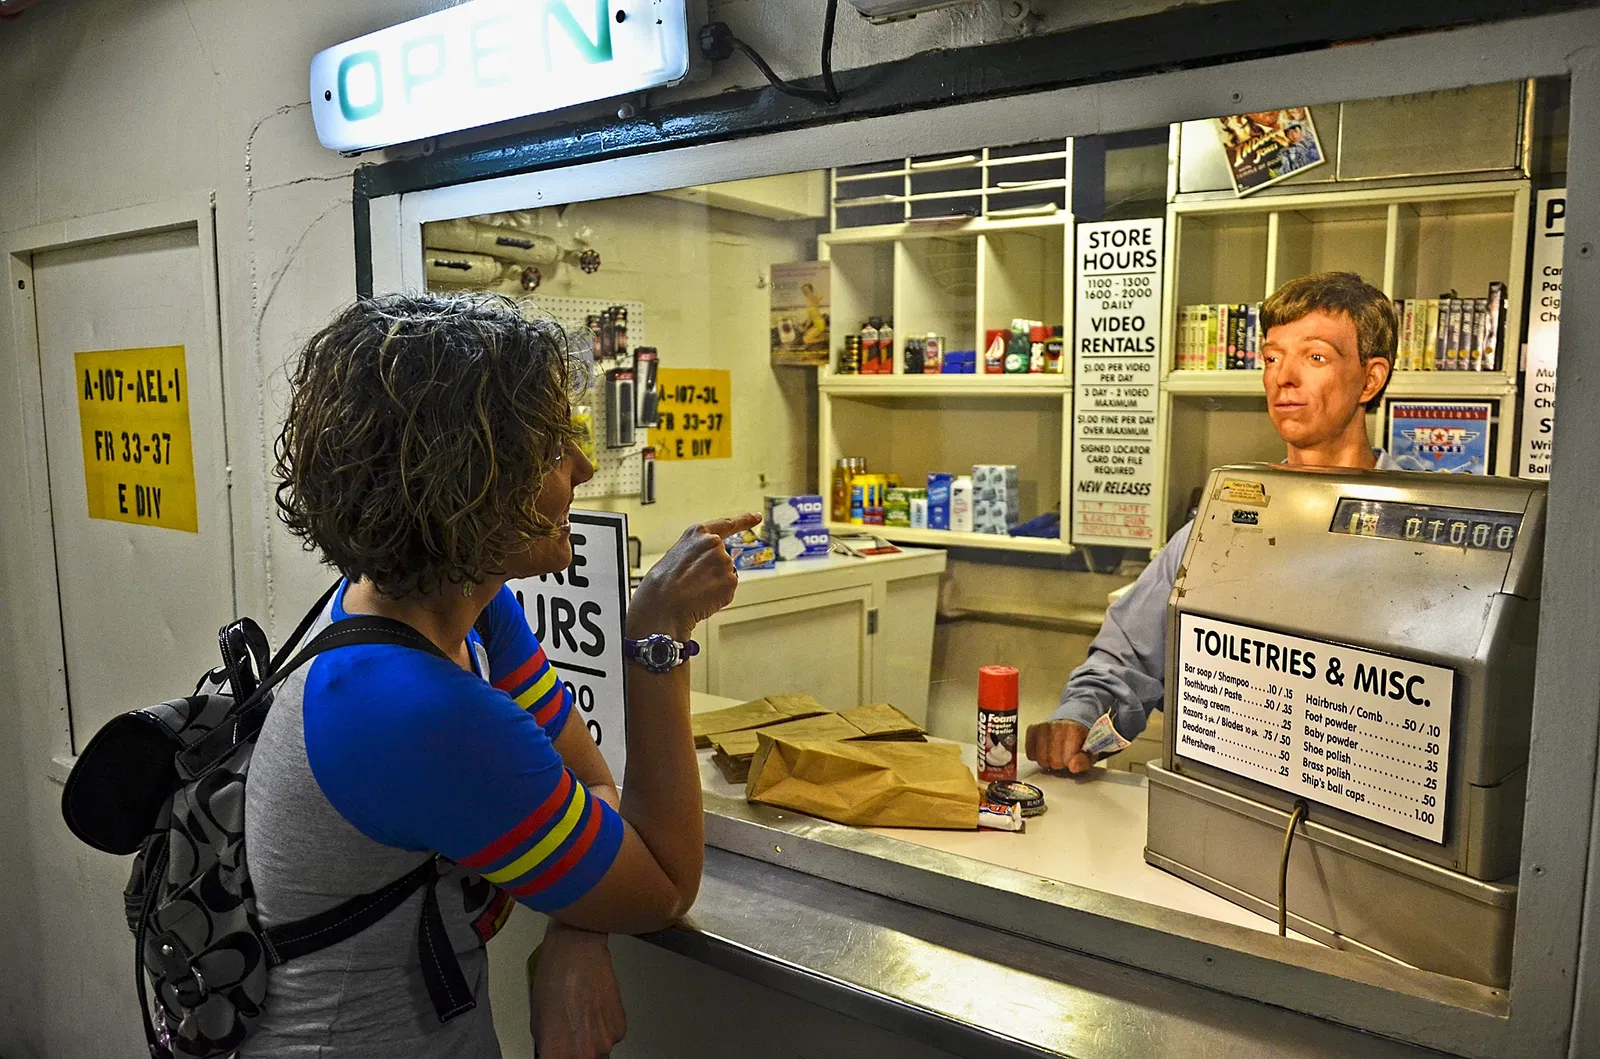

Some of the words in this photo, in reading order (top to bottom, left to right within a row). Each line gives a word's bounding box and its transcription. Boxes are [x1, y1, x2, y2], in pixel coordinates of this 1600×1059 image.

[337, 0, 613, 121] OPEN
[1089, 228, 1152, 249] STORE
[1083, 249, 1157, 270] HOURS
[1088, 279, 1112, 289] 1100
[1122, 276, 1150, 287] 1300
[1085, 290, 1111, 300] 1600
[1122, 288, 1152, 298] 2000
[1101, 300, 1134, 310] DAILY
[1091, 316, 1145, 332] VIDEO
[1081, 336, 1155, 353] RENTALS
[1083, 363, 1105, 373] $1.00
[1107, 363, 1123, 372] PER
[1124, 363, 1151, 372] VIDEO
[1100, 373, 1115, 382] PER
[1119, 373, 1134, 382] DAY
[1084, 388, 1090, 397] 3
[1091, 388, 1107, 397] DAY
[1124, 388, 1149, 397] VIDEO
[1094, 399, 1138, 408] MAXIMUM
[656, 412, 674, 431] FR
[683, 413, 723, 431] 33-37
[1077, 414, 1098, 424] $1.00
[1100, 415, 1118, 424] FINE
[1120, 415, 1138, 425] PER
[1139, 416, 1155, 425] DAY
[1539, 418, 1554, 433] S
[1082, 426, 1104, 435] OVER
[1105, 427, 1149, 436] MAXIMUM
[1414, 427, 1466, 446] HOT
[94, 430, 115, 462] FR
[121, 431, 171, 465] 33-37
[676, 438, 684, 458] E
[692, 438, 712, 457] DIV
[1080, 444, 1111, 453] SIGNED
[1113, 445, 1151, 455] LOCATOR
[1086, 455, 1109, 464] CARD
[1110, 455, 1125, 464] ON
[1127, 456, 1143, 465] FILE
[1094, 466, 1135, 475] REQUIRED
[1077, 480, 1103, 493] NEW
[1103, 482, 1151, 496] RELEASES
[118, 483, 128, 515] E
[135, 484, 161, 519] DIV
[797, 502, 822, 512] 100
[803, 534, 828, 544] 100
[1193, 627, 1317, 680] TOILETRIES
[1325, 657, 1345, 687] &
[1353, 663, 1431, 708] MISC.
[1184, 662, 1196, 673] Bar
[1196, 666, 1212, 680] soap
[1213, 670, 1217, 679] /
[1218, 671, 1249, 688] Shampoo
[1278, 687, 1283, 696] /
[1183, 691, 1209, 709] Shaving
[1210, 700, 1231, 713] cream
[1184, 677, 1218, 695] Toothbrush
[1218, 686, 1223, 696] /
[1224, 688, 1243, 701] Paste
[1276, 702, 1281, 711] /
[1183, 706, 1204, 720] Razors
[1216, 716, 1221, 725] /
[1221, 717, 1244, 732] Blades
[1273, 733, 1278, 742] /
[1305, 693, 1347, 714] Hairbrush
[1349, 705, 1355, 715] /
[1356, 706, 1383, 722] Comb
[1418, 723, 1425, 733] /
[1426, 724, 1440, 738] .10
[1305, 710, 1323, 723] Foot
[1324, 716, 1357, 732] powder
[1182, 720, 1217, 738] Deodorant
[1304, 725, 1325, 742] Baby
[1326, 732, 1358, 750] powder
[978, 712, 987, 773] Gillette
[1181, 734, 1216, 753] Aftershave
[1303, 741, 1323, 756] Shoe
[1326, 750, 1351, 765] polish
[1302, 757, 1324, 772] Brass
[1326, 766, 1351, 781] polish
[1301, 772, 1325, 789] Ship's
[1327, 781, 1343, 795] ball
[1345, 788, 1365, 803] caps
[1414, 809, 1434, 825] 1.00
